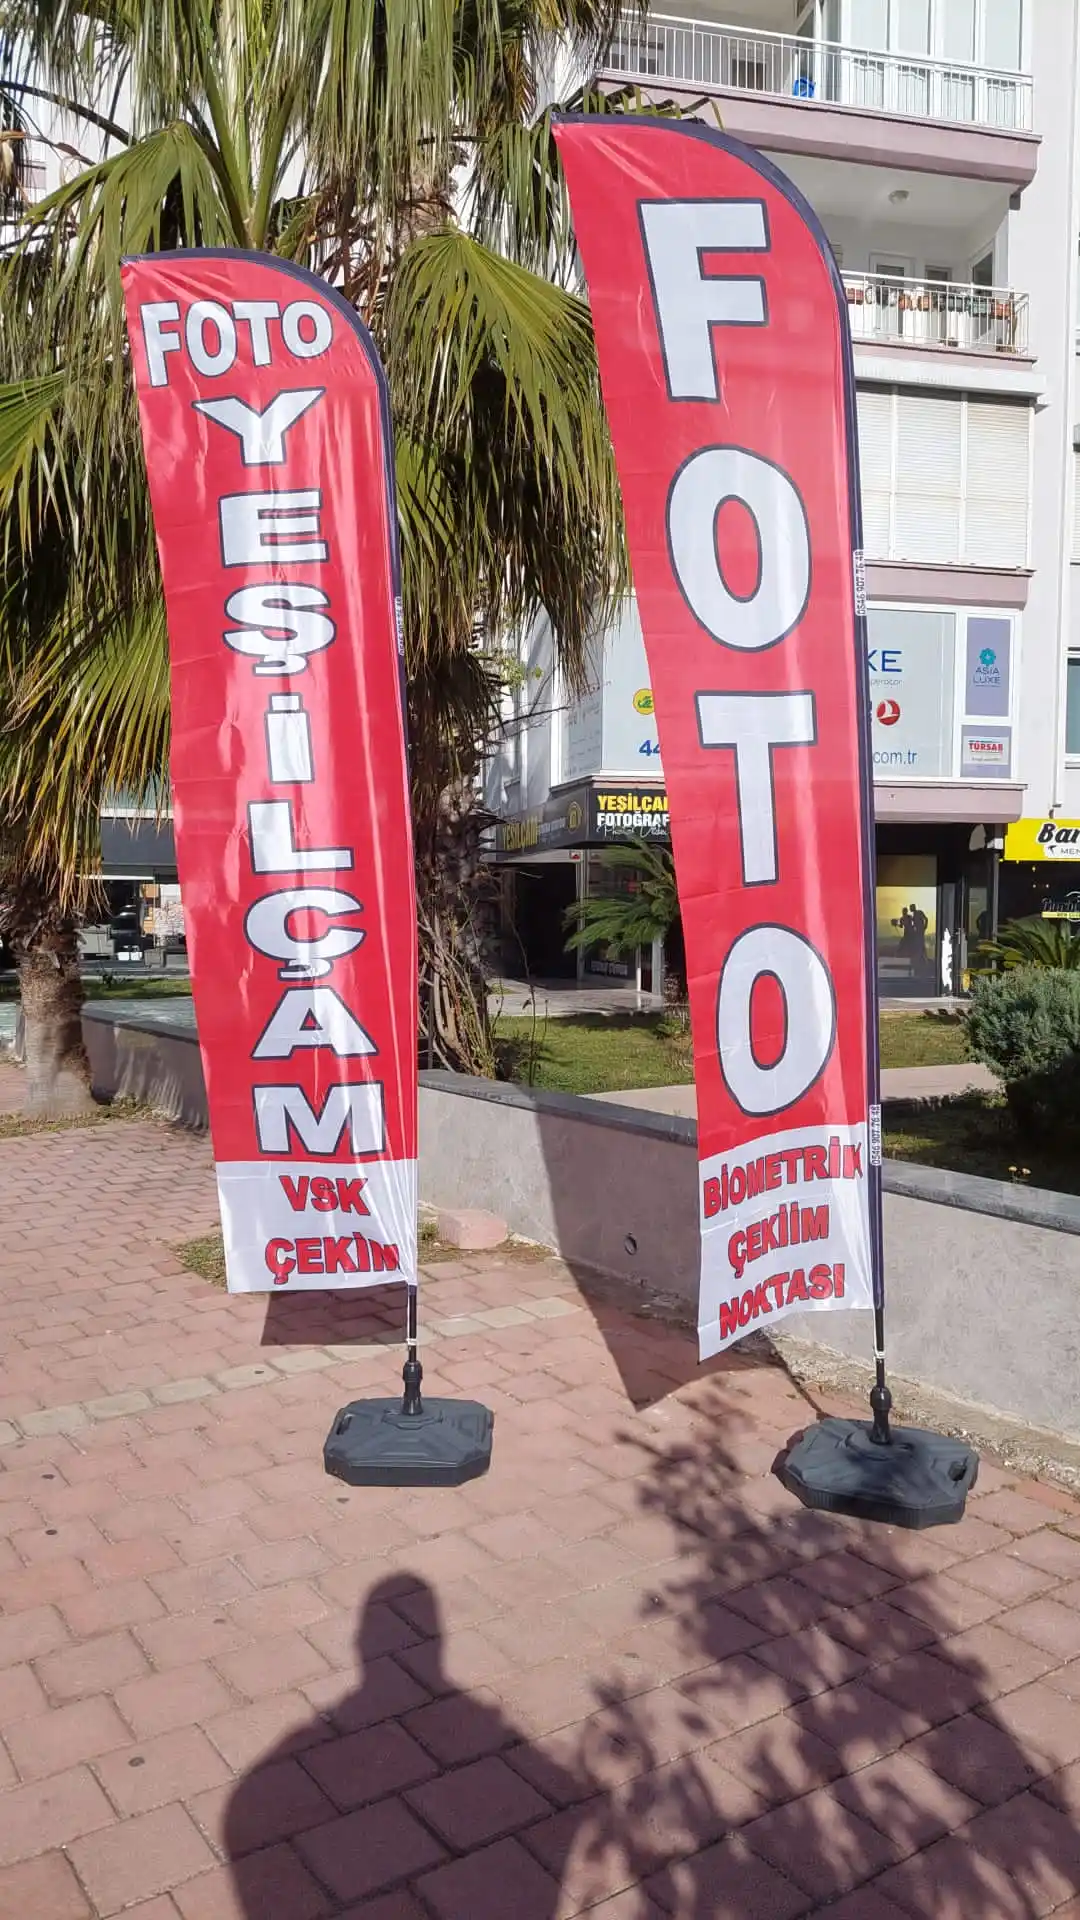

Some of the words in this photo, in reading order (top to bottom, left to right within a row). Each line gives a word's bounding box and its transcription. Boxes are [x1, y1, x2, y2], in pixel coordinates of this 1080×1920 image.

[140, 300, 333, 387] FOTO
[637, 198, 837, 1117] FOTO
[192, 387, 386, 1156] YEŞİLÇAM
[278, 1175, 371, 1216] VSK
[703, 1136, 864, 1219] BİOMETRİK
[718, 1263, 845, 1340] NOKTASI
